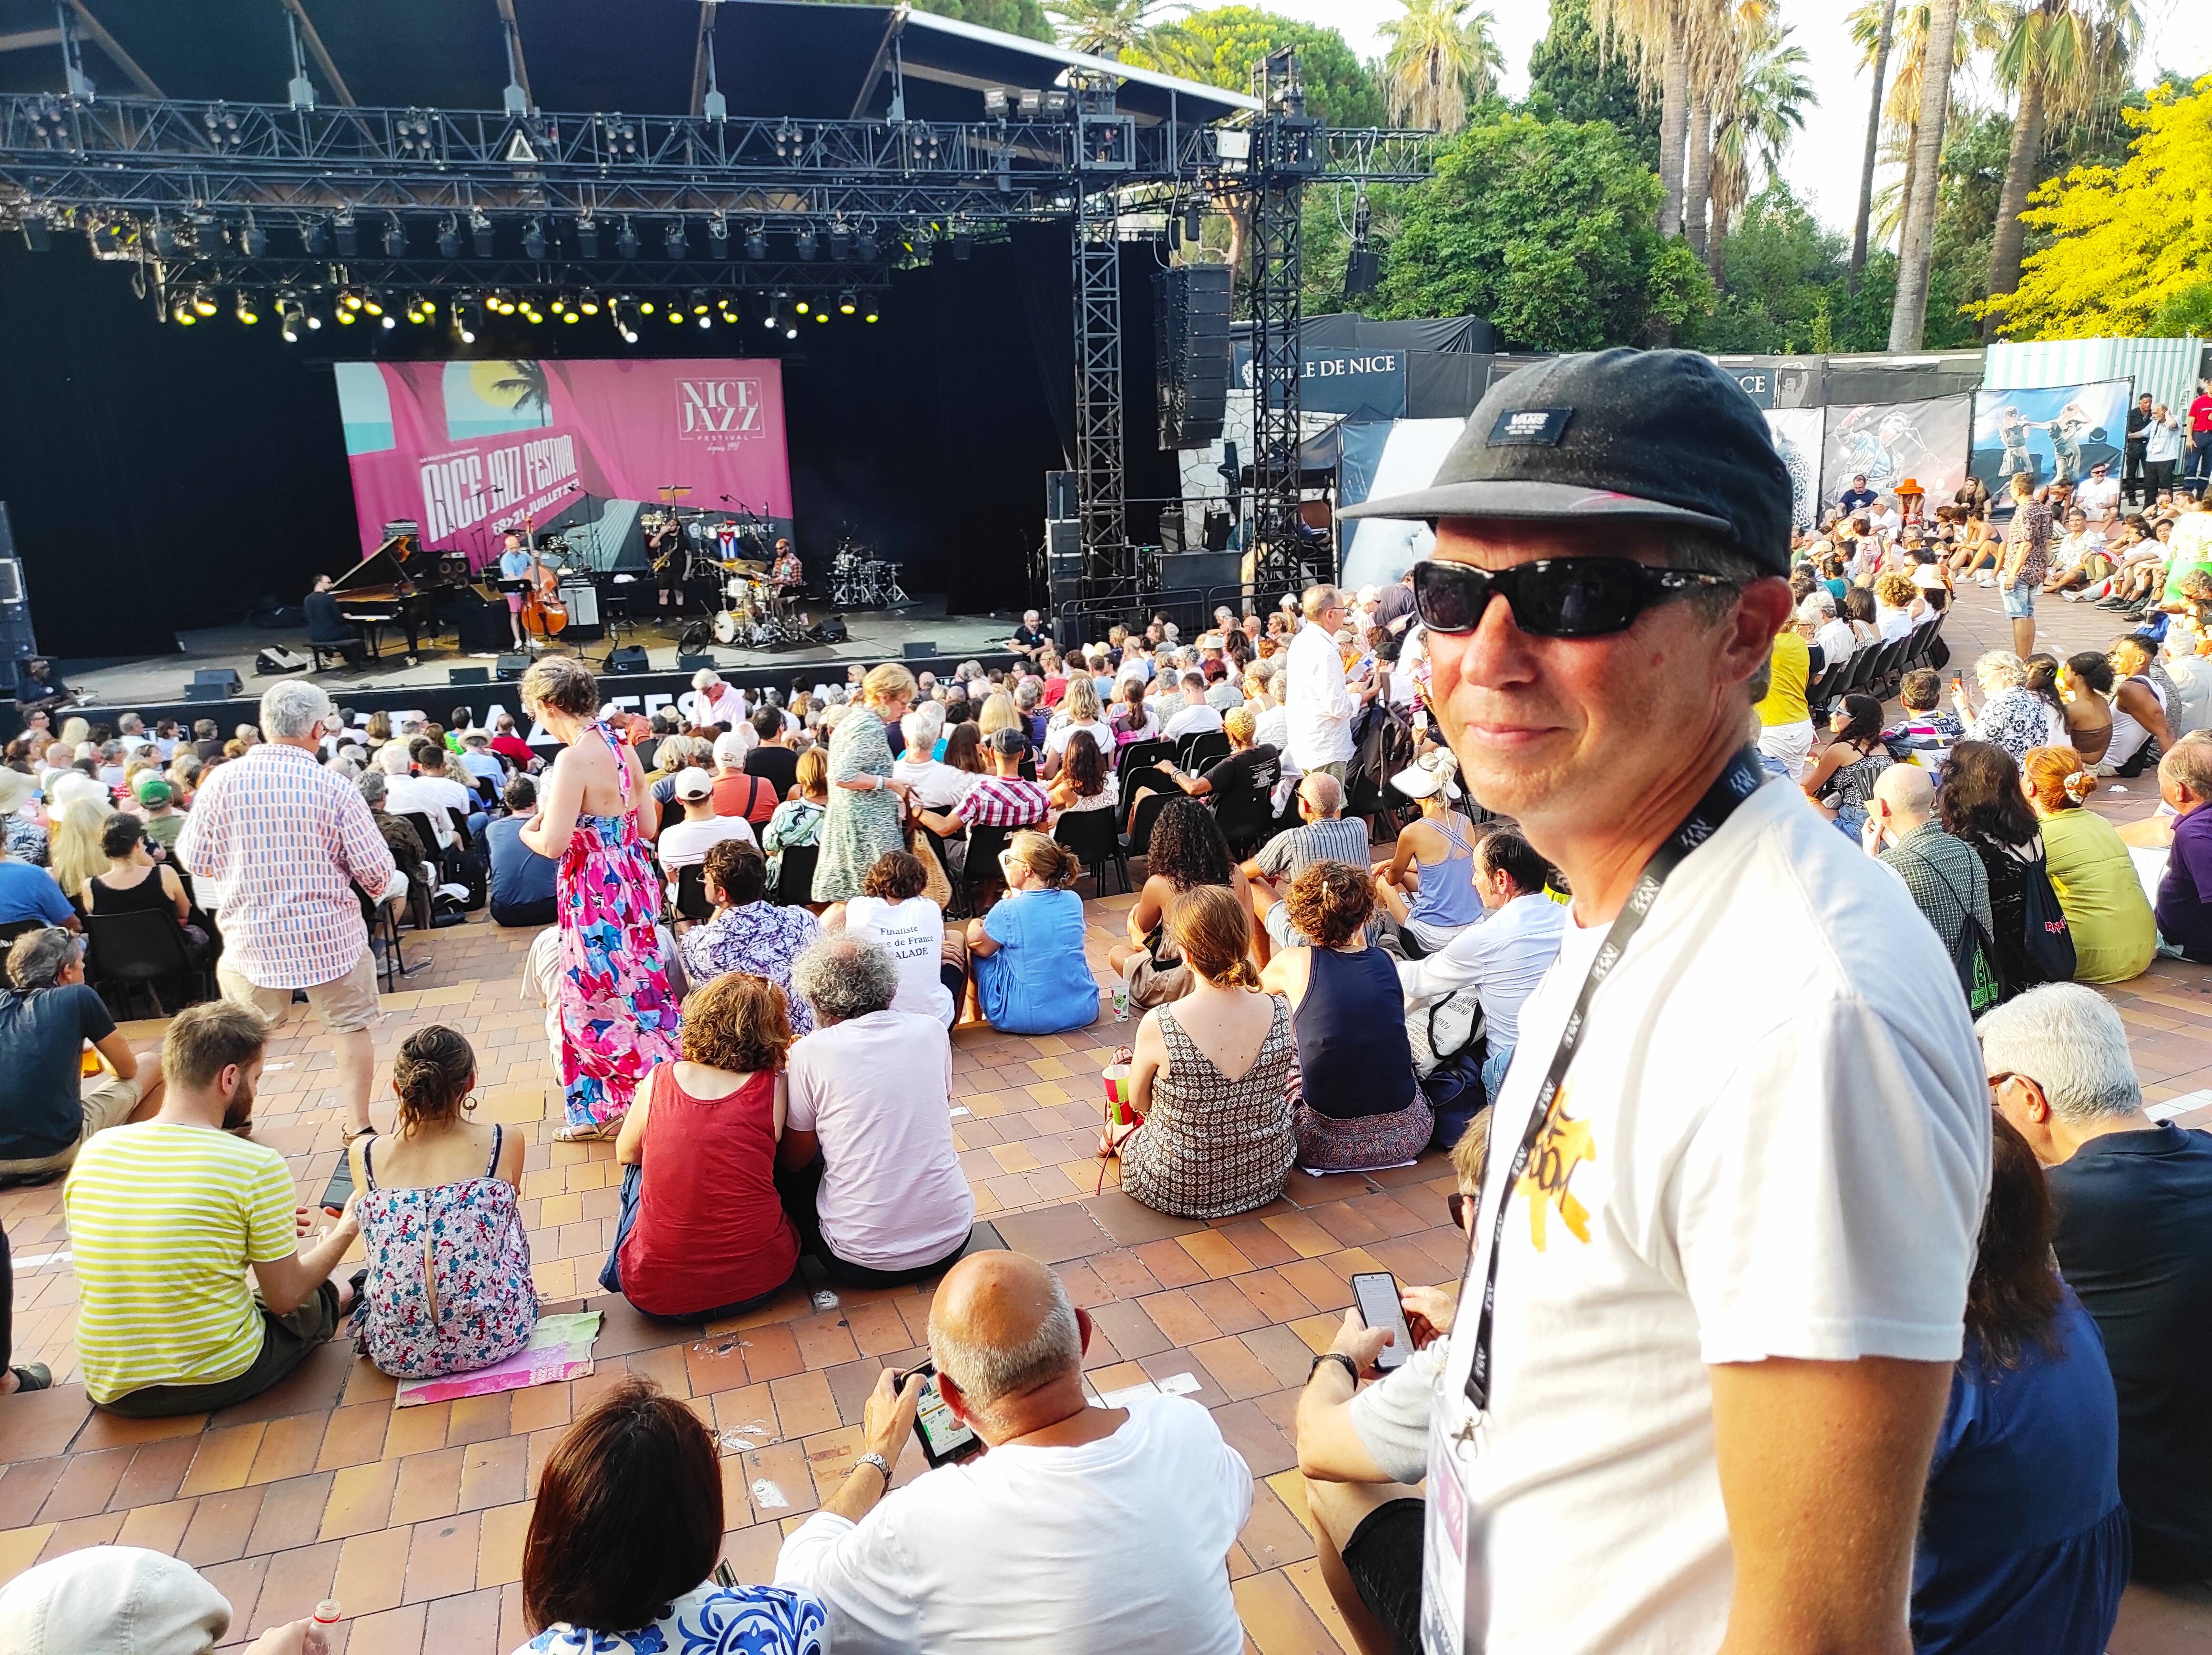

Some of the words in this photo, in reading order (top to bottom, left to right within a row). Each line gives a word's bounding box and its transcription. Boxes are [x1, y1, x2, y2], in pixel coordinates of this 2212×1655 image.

[1270, 362, 1315, 379] VILE
[1320, 359, 1345, 376] DE
[1349, 355, 1395, 374] NICE
[682, 381, 759, 408] NICE
[1740, 376, 1765, 393] CE
[684, 402, 761, 433] JAZZ
[421, 455, 488, 543] NICE
[487, 446, 526, 515] JAZZ
[523, 434, 578, 495] FESTIVAL
[525, 486, 563, 517] JUILLET
[880, 926, 919, 936] Finaliste
[894, 939, 906, 947] de
[908, 935, 933, 945] France
[895, 947, 928, 960] ALADE
